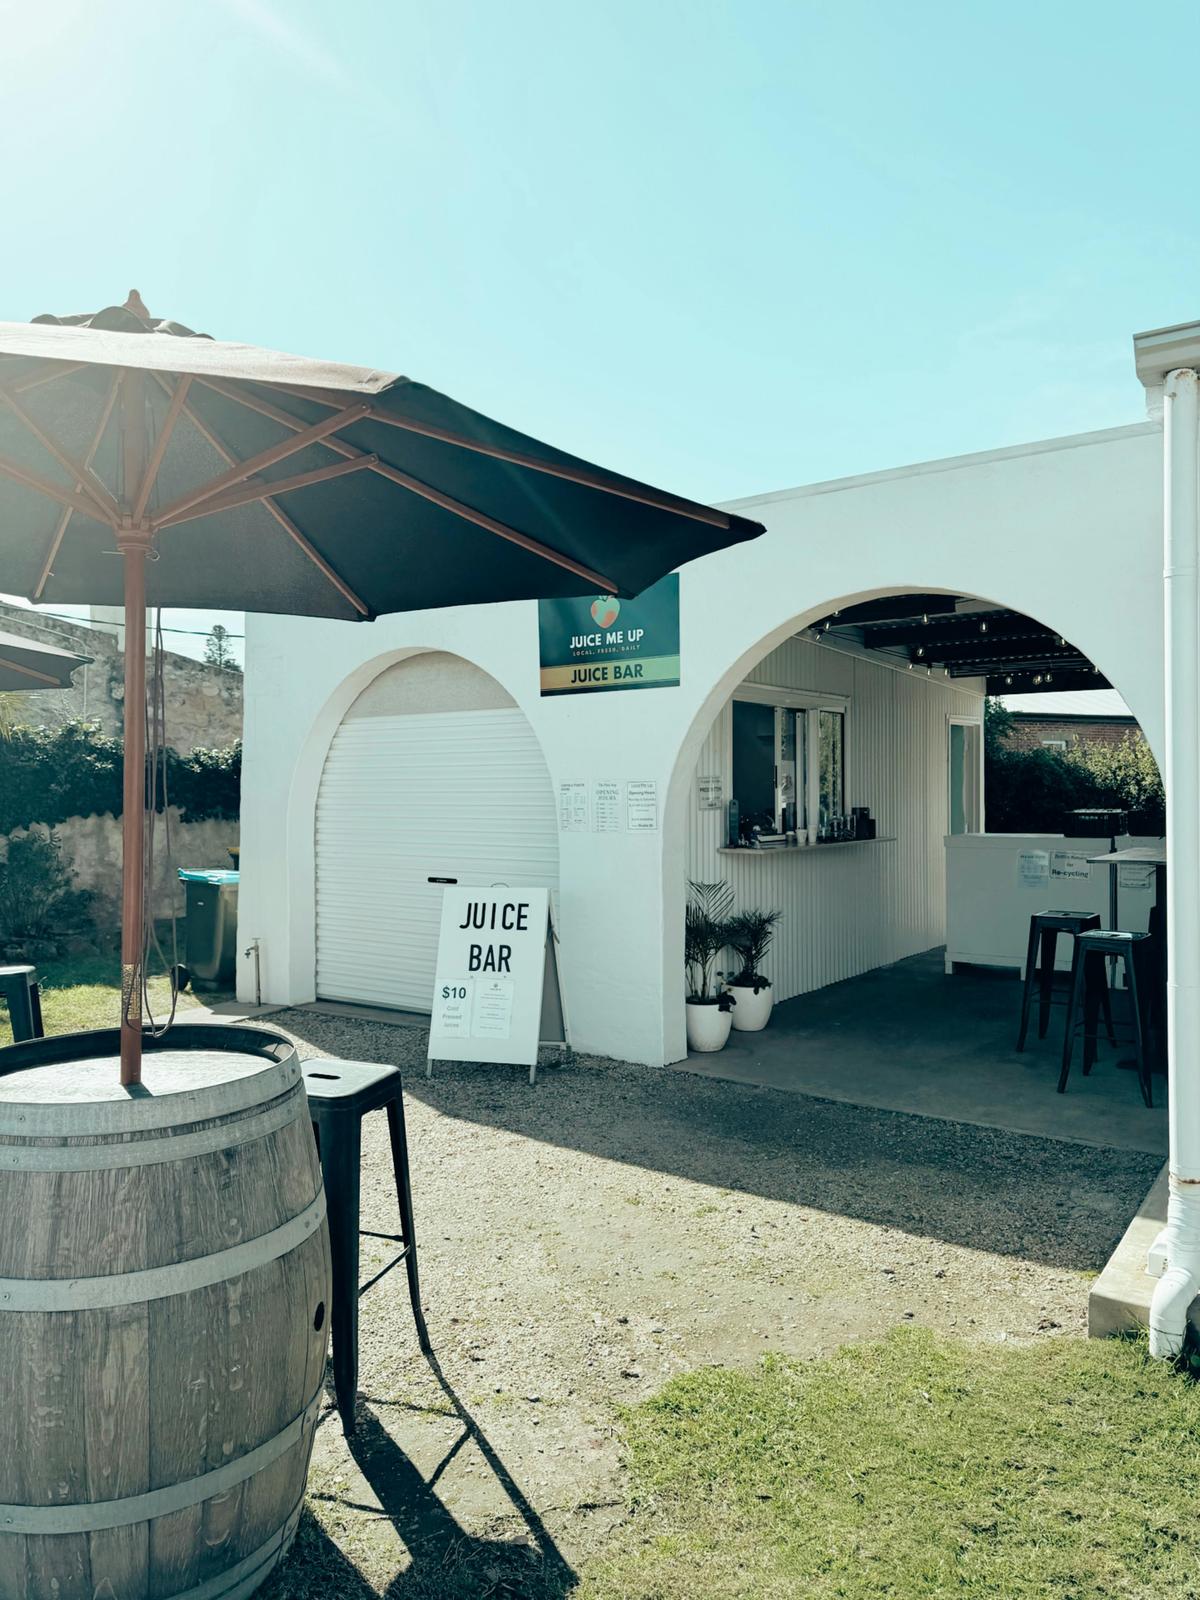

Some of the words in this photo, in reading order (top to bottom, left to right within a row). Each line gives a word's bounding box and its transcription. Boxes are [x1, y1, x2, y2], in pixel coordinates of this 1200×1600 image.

[569, 634, 602, 649] JUICE
[606, 631, 624, 645] ME
[627, 628, 645, 642] UP
[570, 667, 608, 684] JUICE
[613, 664, 644, 680] BAR
[1051, 868, 1089, 879] Re-cycling
[459, 902, 530, 931] JUICE
[468, 944, 512, 973] BAR
[442, 985, 467, 1000] $10
